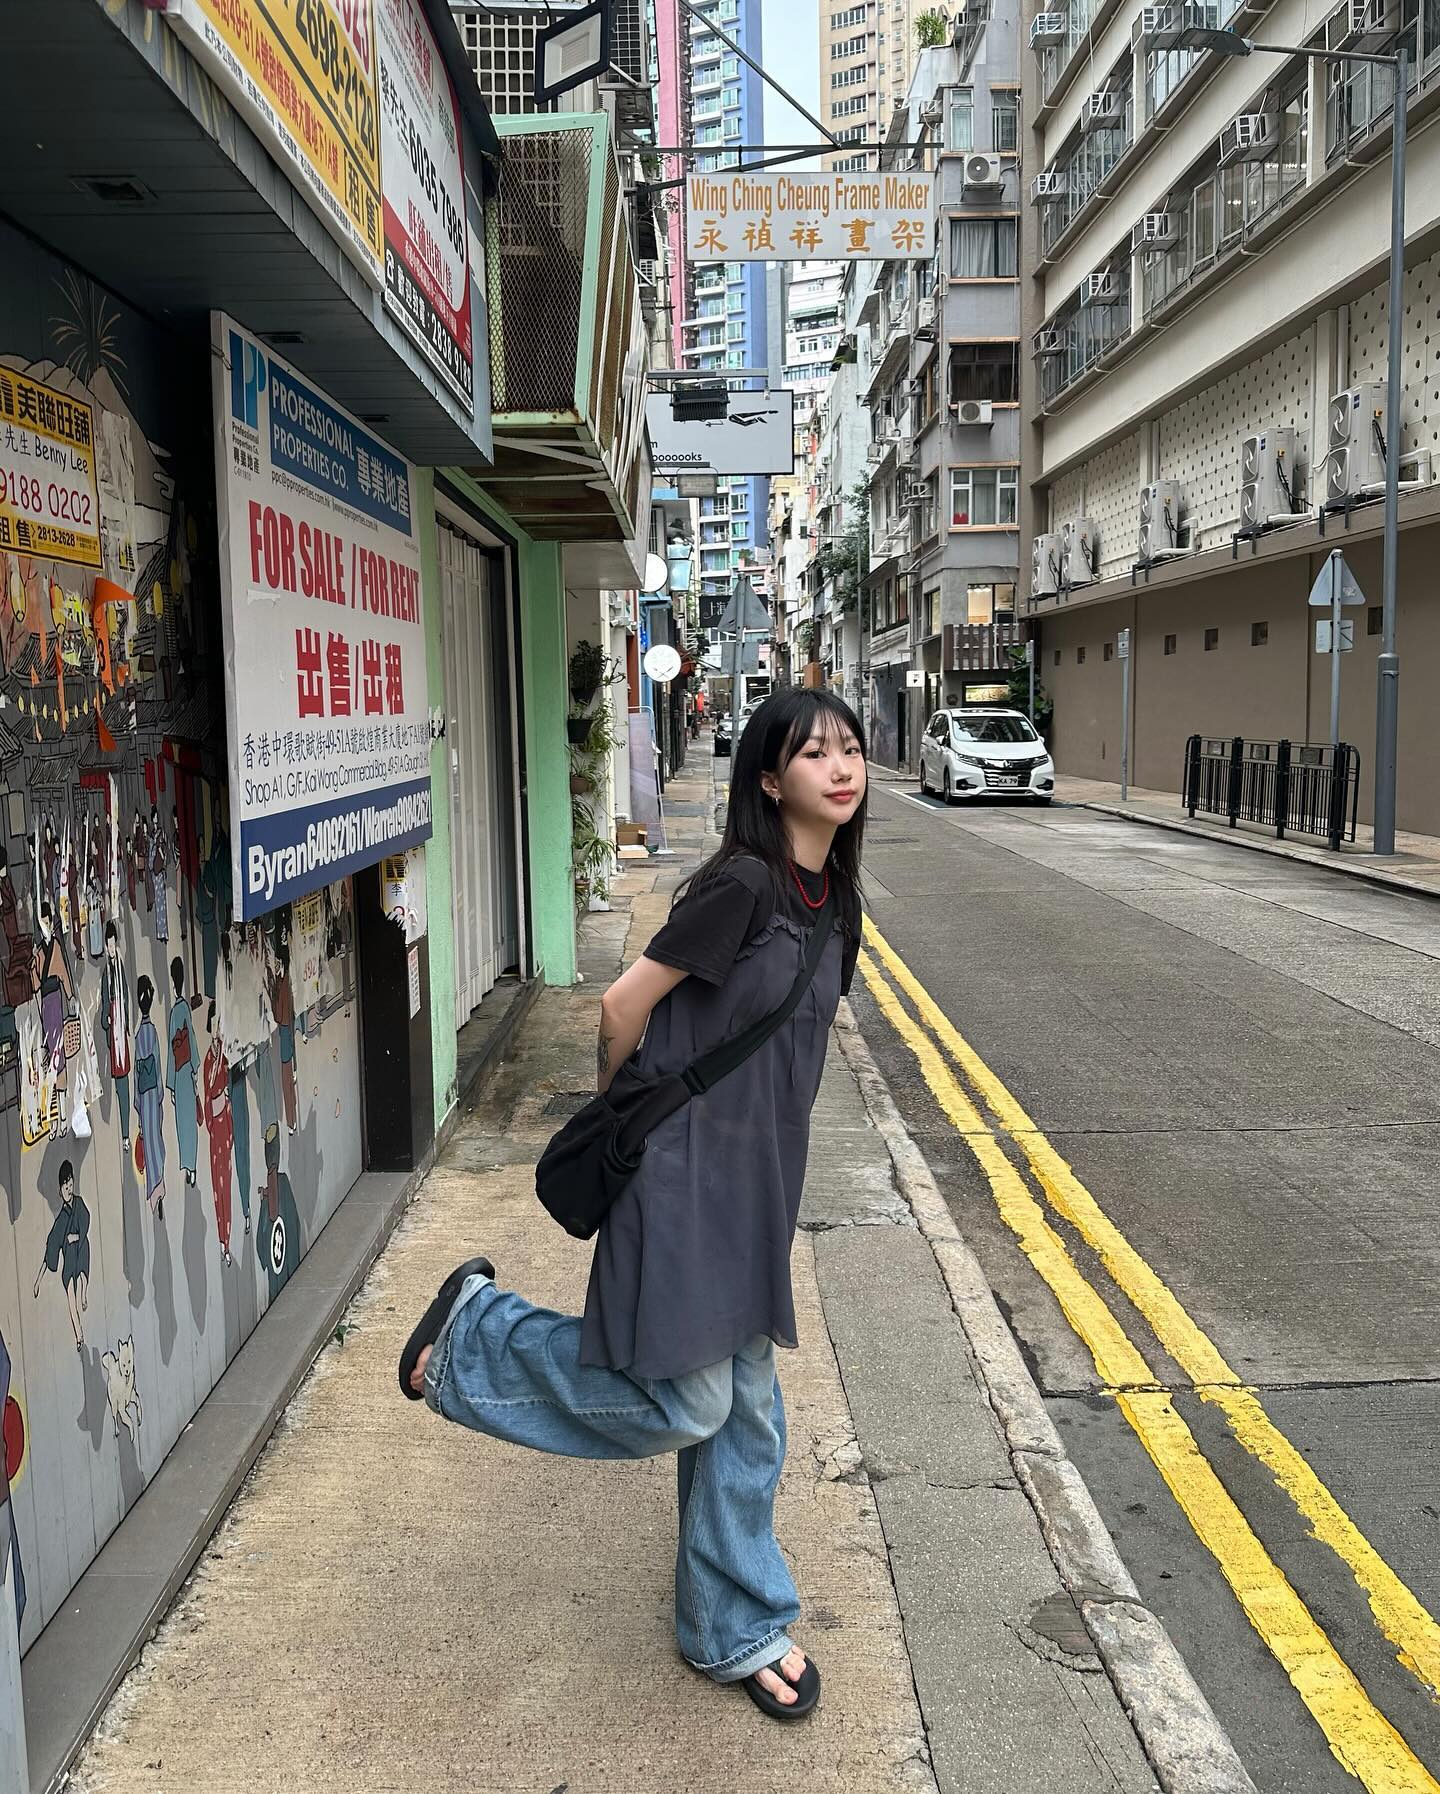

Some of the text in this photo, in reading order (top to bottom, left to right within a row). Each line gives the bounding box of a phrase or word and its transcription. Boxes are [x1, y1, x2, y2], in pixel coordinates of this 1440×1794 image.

[409, 118, 437, 214] 6035
[440, 178, 464, 264] 7986
[691, 176, 930, 218] Wing Ching Cheung Frame Maker
[693, 217, 926, 254] 永禎祥畫架
[431, 312, 452, 366] 2838
[454, 347, 472, 393] 9188
[17, 382, 91, 447] 美聯旺舖
[272, 375, 354, 461] PROFESSIONAL
[0, 423, 31, 456] 先生
[35, 434, 67, 472] Benny
[70, 448, 88, 474] Lee
[273, 424, 349, 492] PROPERTIES CO.
[0, 467, 91, 525] 9188 0202
[355, 446, 410, 519] 專業地產
[37, 525, 76, 547] 2813-2628
[248, 500, 297, 593] FOR
[298, 520, 346, 605] SALE
[359, 546, 390, 616] FOR
[390, 558, 420, 625] RENT
[295, 626, 405, 719] 出售/出租
[245, 778, 271, 809] Shop
[304, 769, 317, 793] Kai
[317, 767, 339, 793] Wong
[338, 760, 374, 787] Commercial
